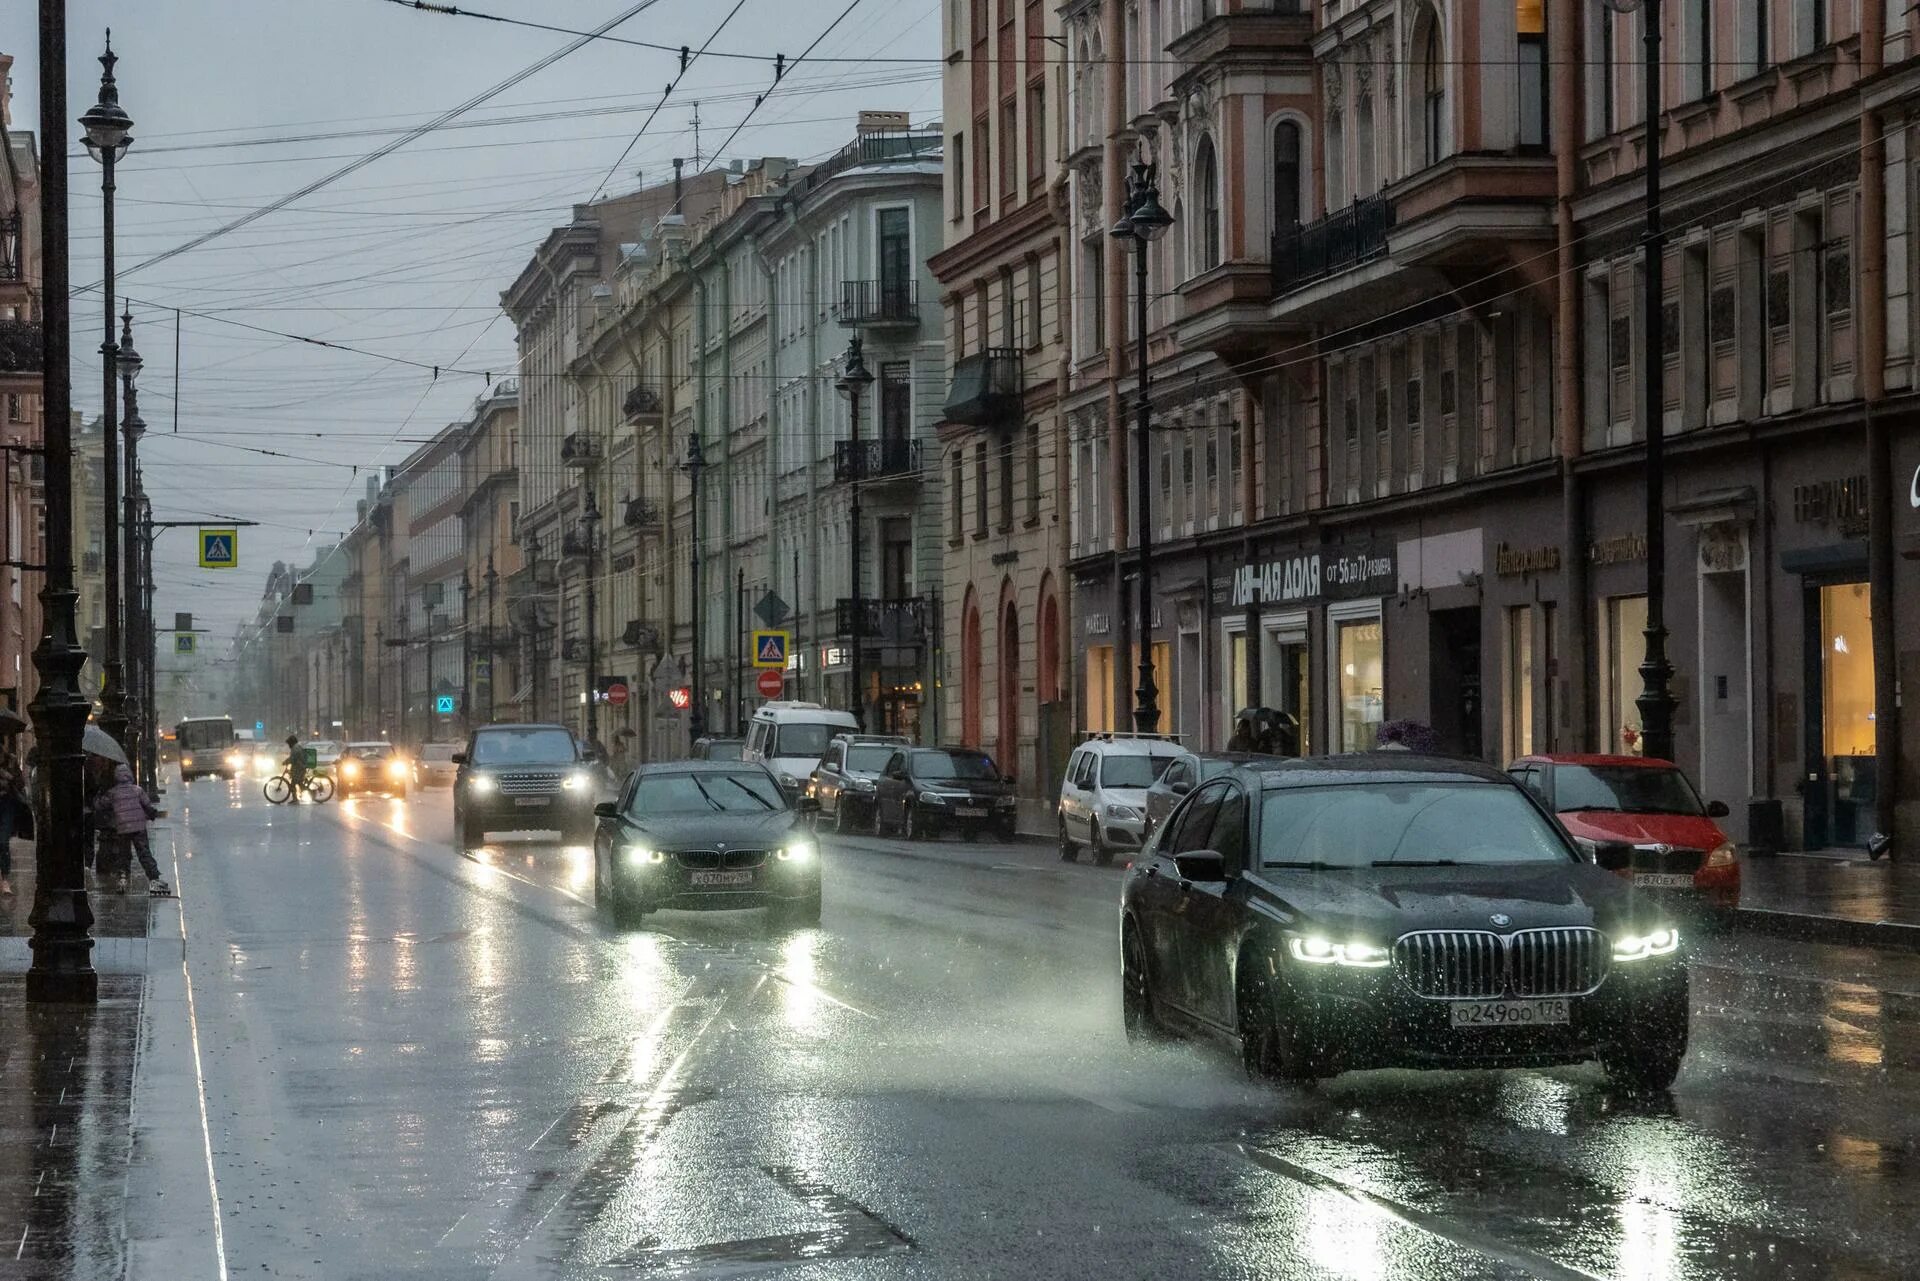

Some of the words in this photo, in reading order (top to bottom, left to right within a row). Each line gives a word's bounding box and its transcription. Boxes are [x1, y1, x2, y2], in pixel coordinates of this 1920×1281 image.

[1283, 555, 1321, 600] ДОЛЯ
[1339, 557, 1350, 584] 56
[1358, 555, 1367, 581] 72
